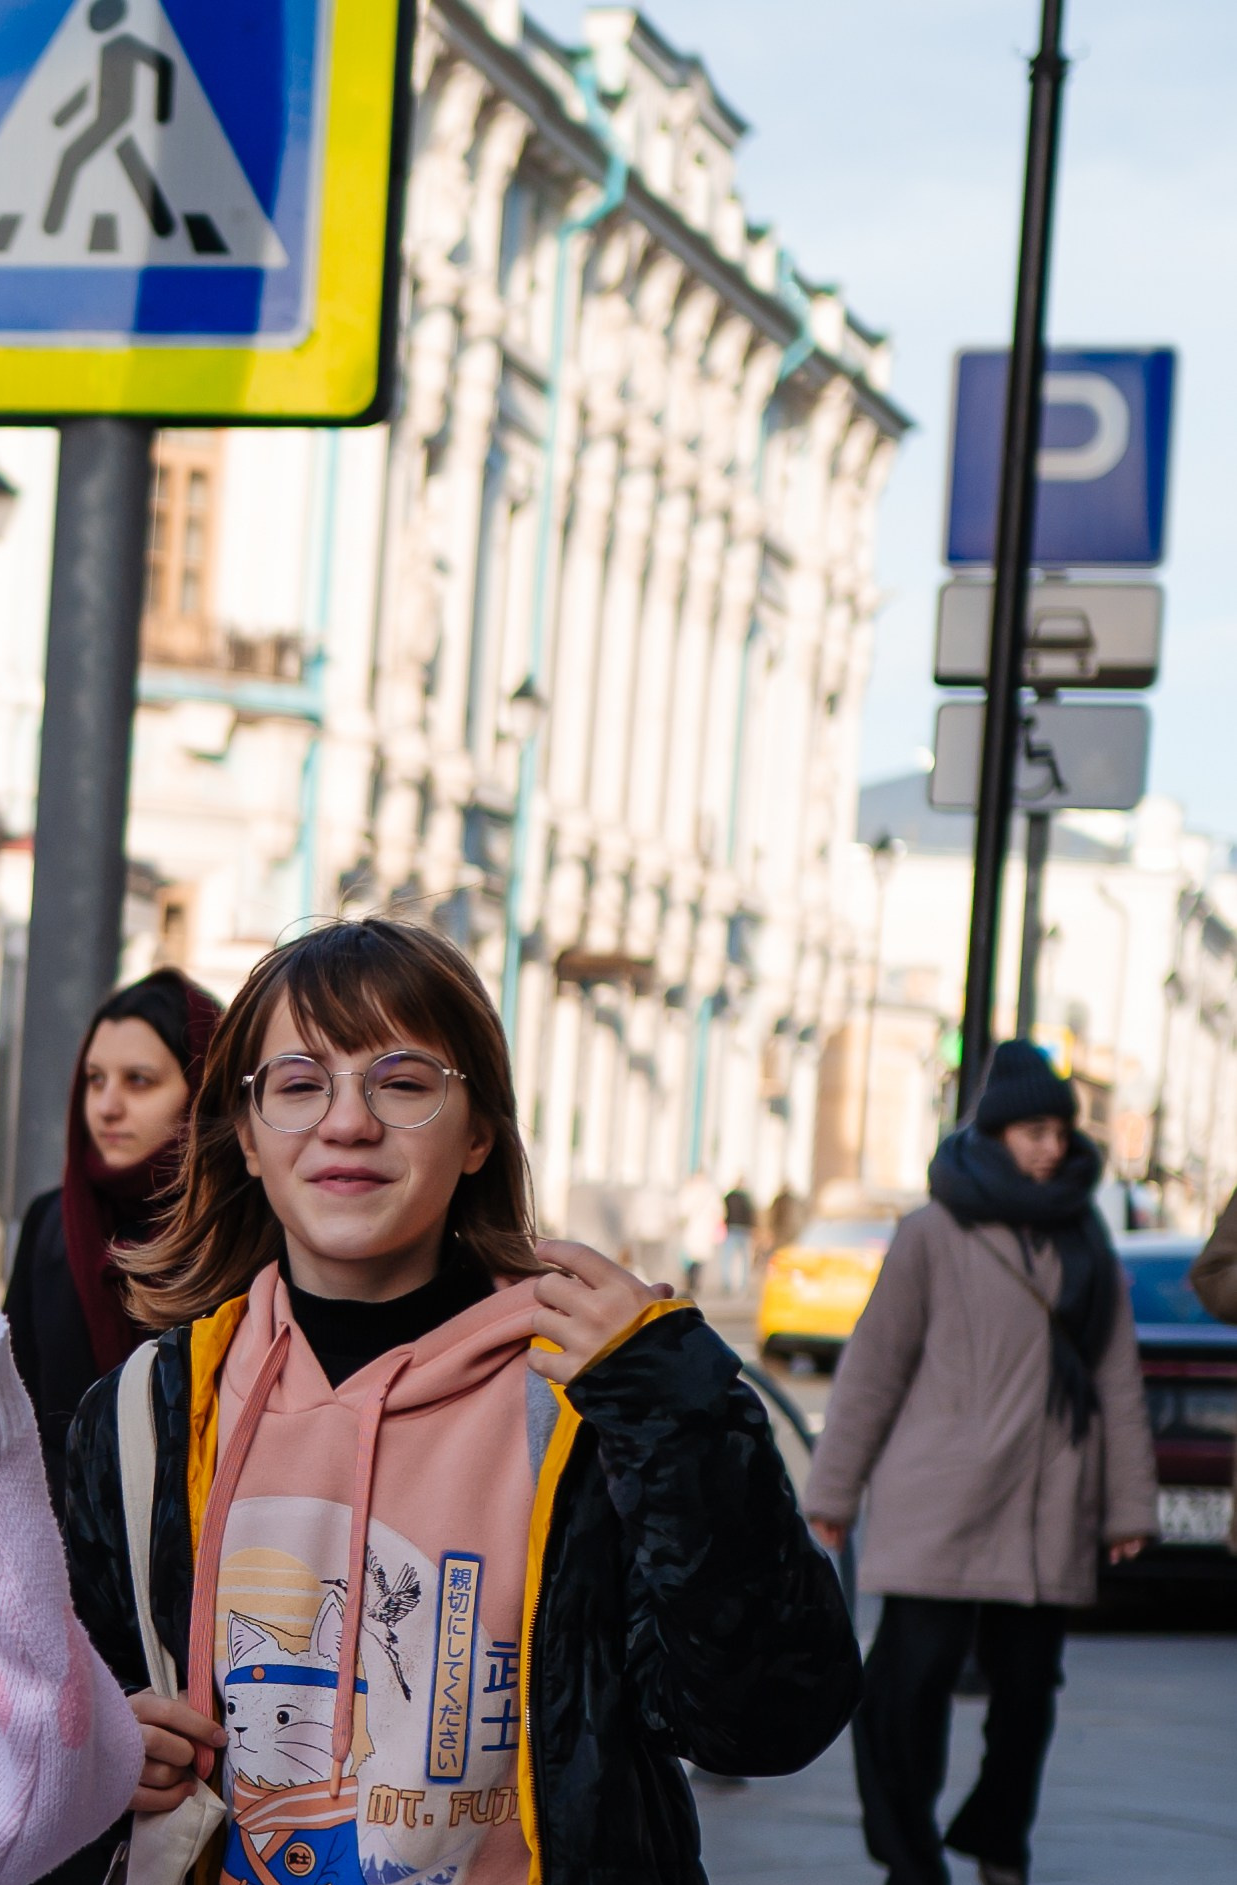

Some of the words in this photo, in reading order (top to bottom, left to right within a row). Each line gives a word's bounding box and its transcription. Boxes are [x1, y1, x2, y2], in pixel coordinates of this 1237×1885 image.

[436, 1566, 473, 1771] 親切にしてください
[367, 1784, 434, 1829] MT.
